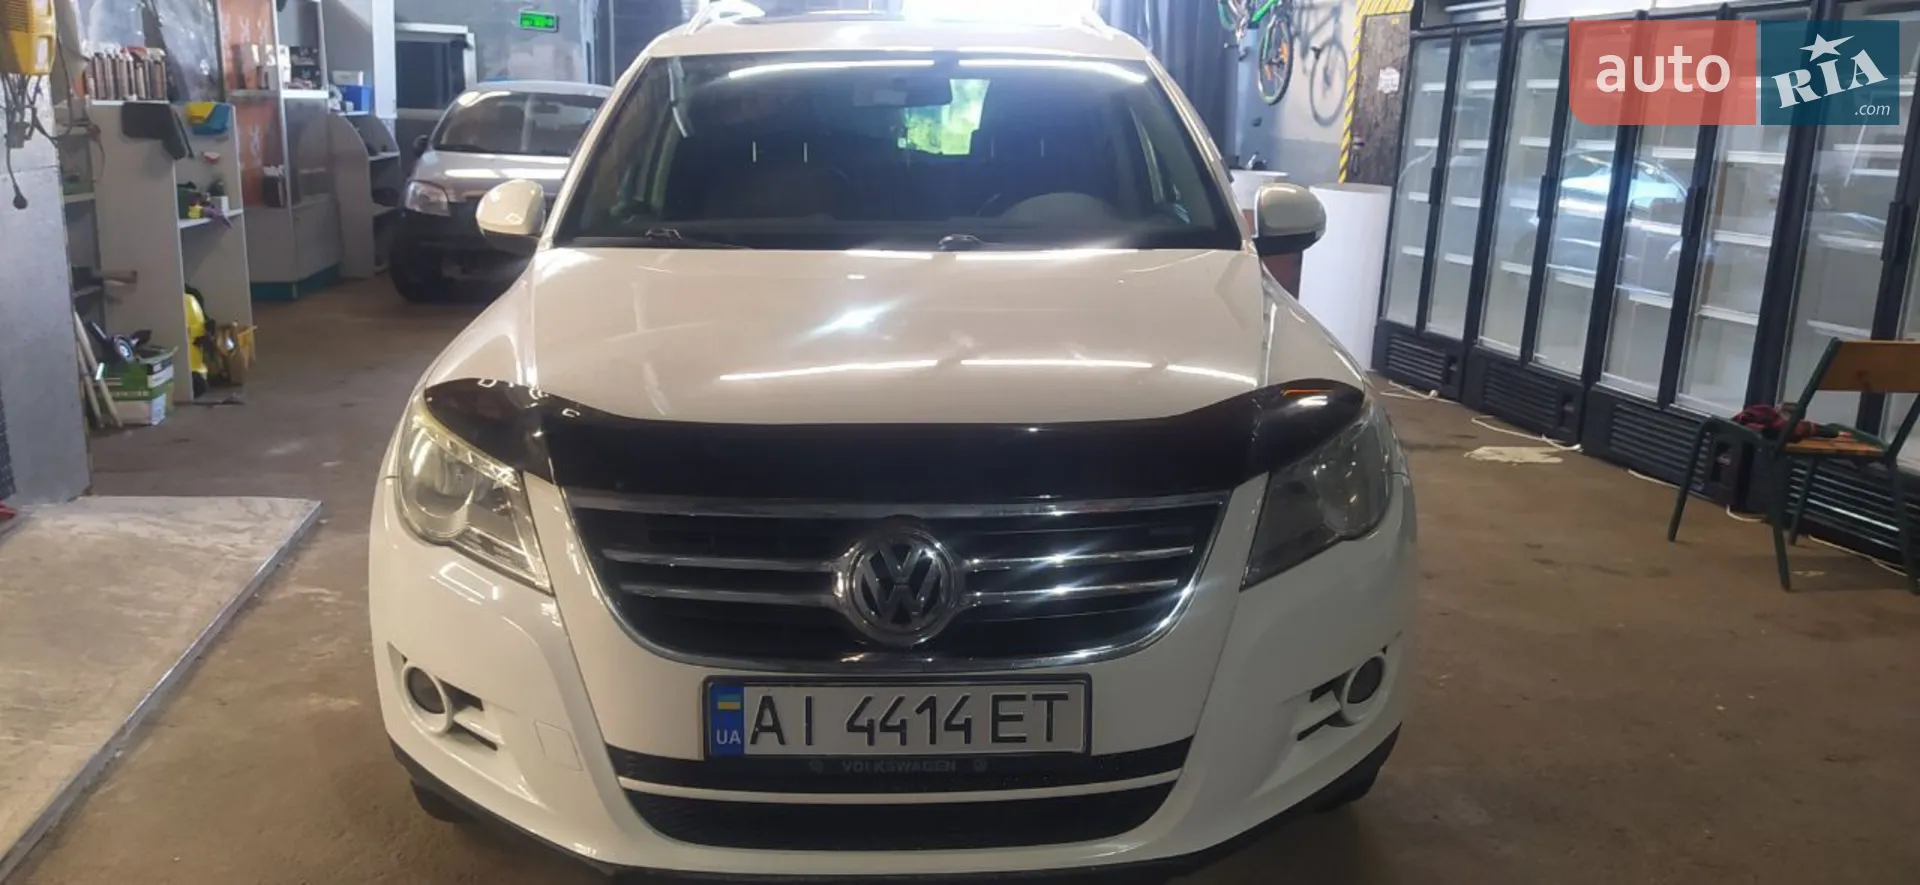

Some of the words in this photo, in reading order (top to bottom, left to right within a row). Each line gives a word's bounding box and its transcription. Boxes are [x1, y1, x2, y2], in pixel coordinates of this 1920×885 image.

[750, 695, 813, 746] AI
[846, 694, 972, 746] 4414
[990, 693, 1069, 743] ET
[716, 730, 741, 745] UA
